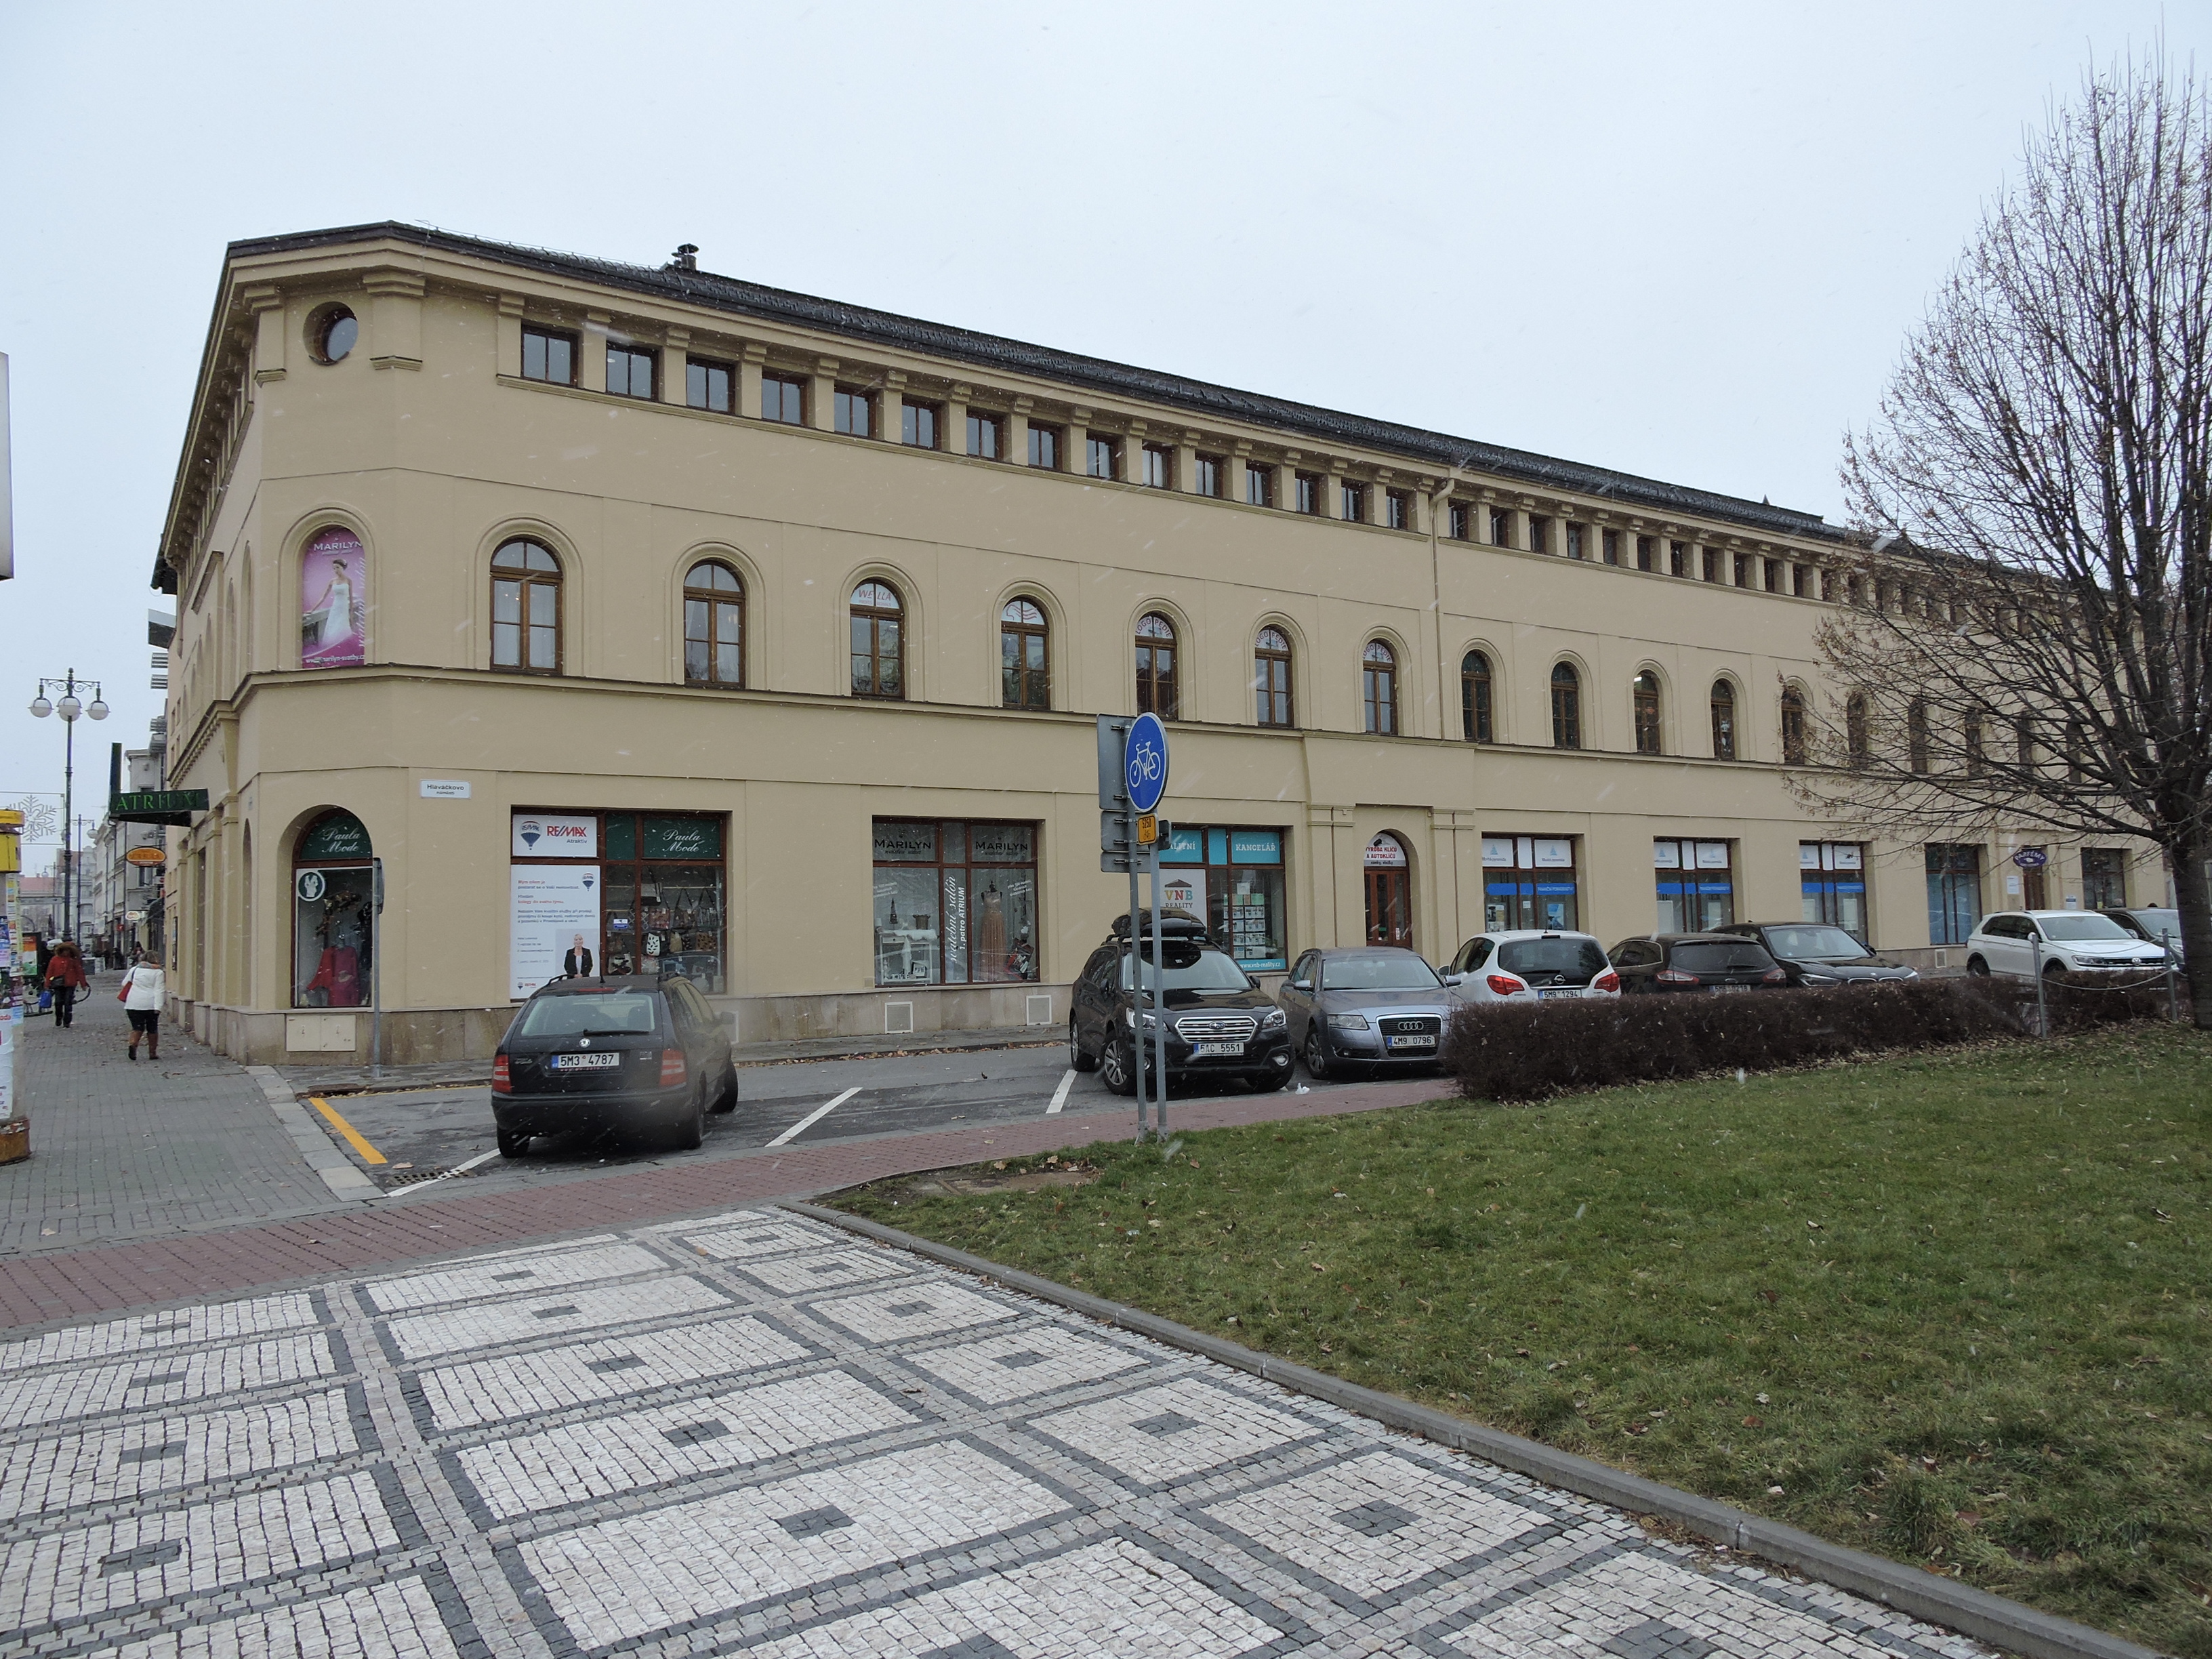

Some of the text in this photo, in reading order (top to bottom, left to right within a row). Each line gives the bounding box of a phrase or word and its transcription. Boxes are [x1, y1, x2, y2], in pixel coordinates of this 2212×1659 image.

[314, 541, 363, 552] MARILYN
[115, 791, 201, 811] ATRIUM
[1142, 818, 1151, 828] 5250
[323, 827, 361, 841] Paula
[547, 825, 587, 838] RE/MAX
[663, 829, 701, 842] Paula
[322, 841, 360, 853] Mode
[662, 840, 699, 853] Mode
[874, 839, 932, 849] MARILYN
[976, 841, 1028, 851] MARILYN
[1170, 841, 1195, 851] ALITNÍ
[1235, 842, 1276, 851] KANCELÁŘ
[2014, 850, 2045, 861] PARFÉMY
[1164, 890, 1193, 901] VNB
[945, 911, 958, 963] svatební
[1543, 989, 1578, 999] 5M9 1294
[1393, 1036, 1432, 1046] 4M9 0796
[1200, 1043, 1242, 1053] 5AC 5551
[560, 1054, 615, 1067] 5M3 4787
